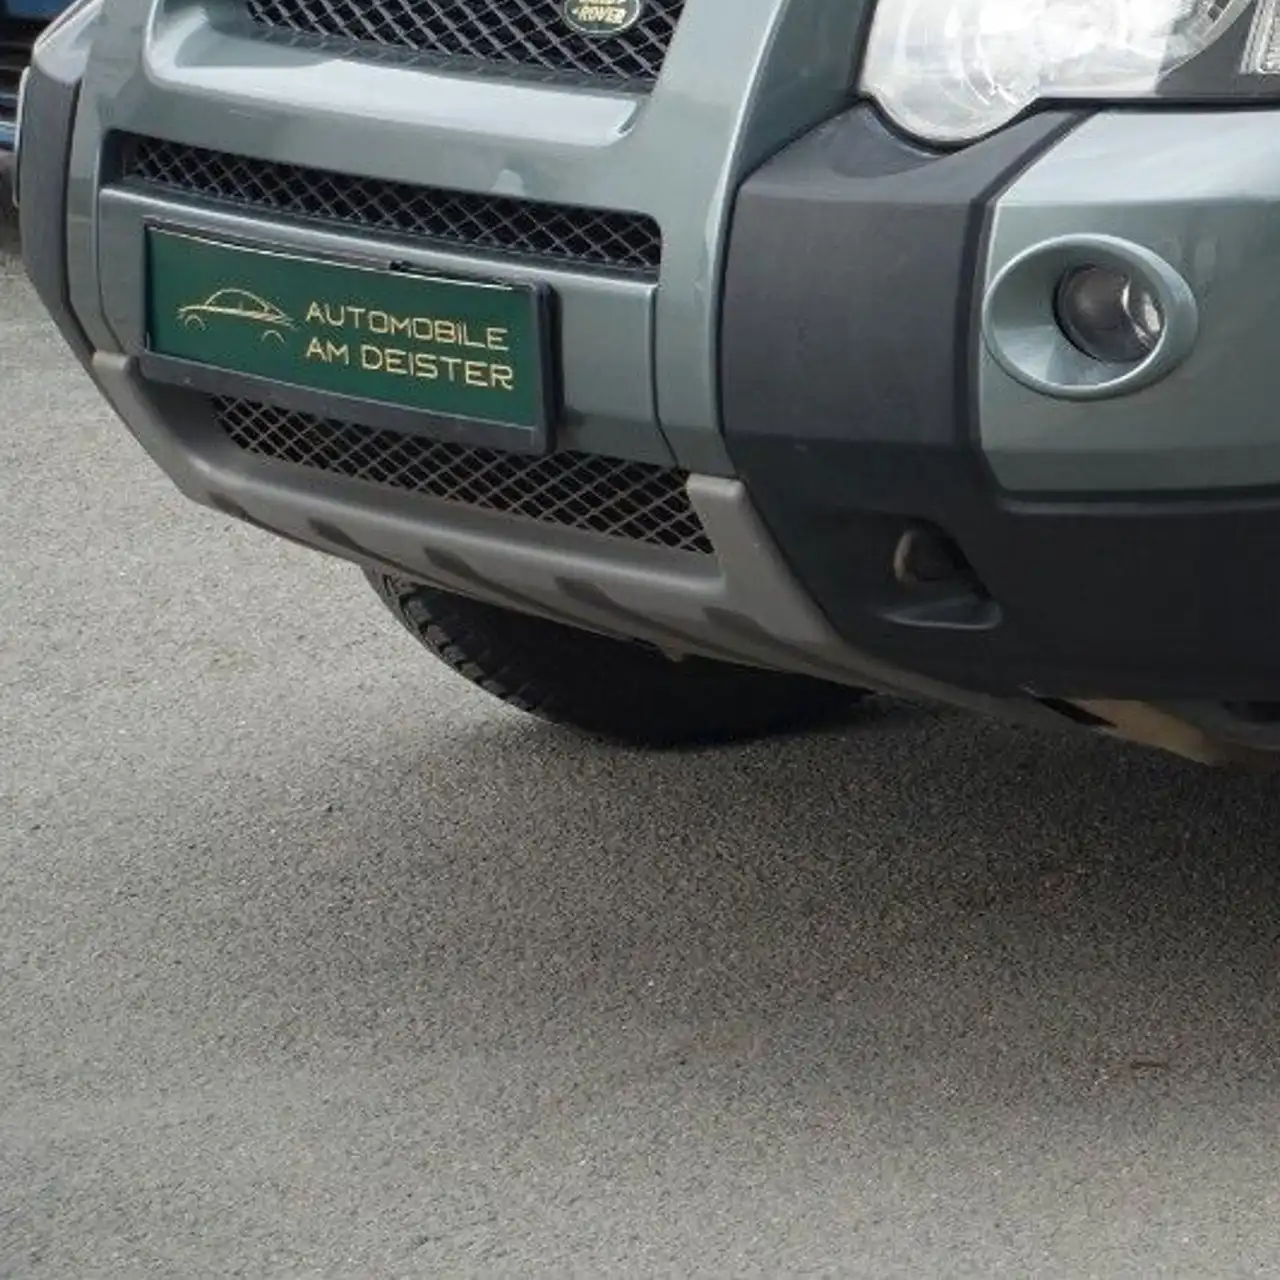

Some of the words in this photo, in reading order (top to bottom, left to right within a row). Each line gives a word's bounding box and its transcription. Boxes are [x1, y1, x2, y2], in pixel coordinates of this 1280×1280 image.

[306, 300, 511, 351] AUTOMOBILE
[306, 336, 349, 366] AM
[361, 344, 514, 391] DEISTER
